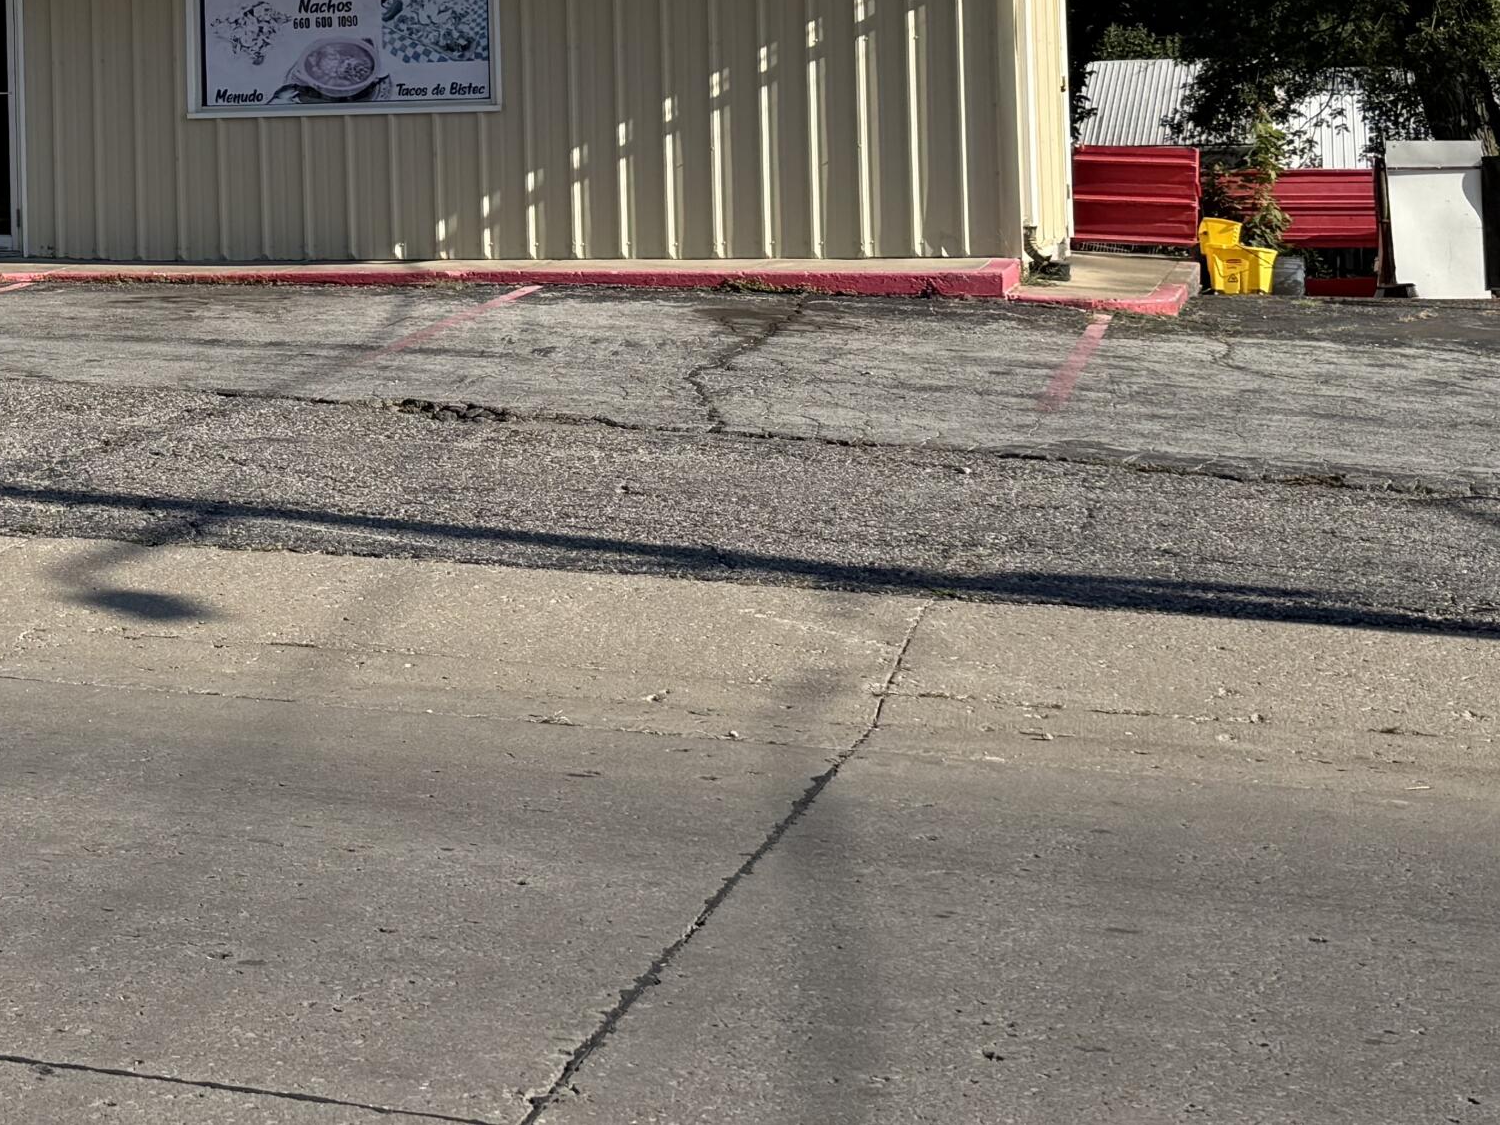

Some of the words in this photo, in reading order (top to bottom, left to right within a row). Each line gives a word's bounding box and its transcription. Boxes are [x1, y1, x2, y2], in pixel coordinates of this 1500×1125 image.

[293, 17, 311, 29] 660
[215, 88, 264, 104] Menudo
[396, 83, 428, 97] Tacos
[431, 83, 446, 96] de
[449, 81, 486, 96] Bistec
